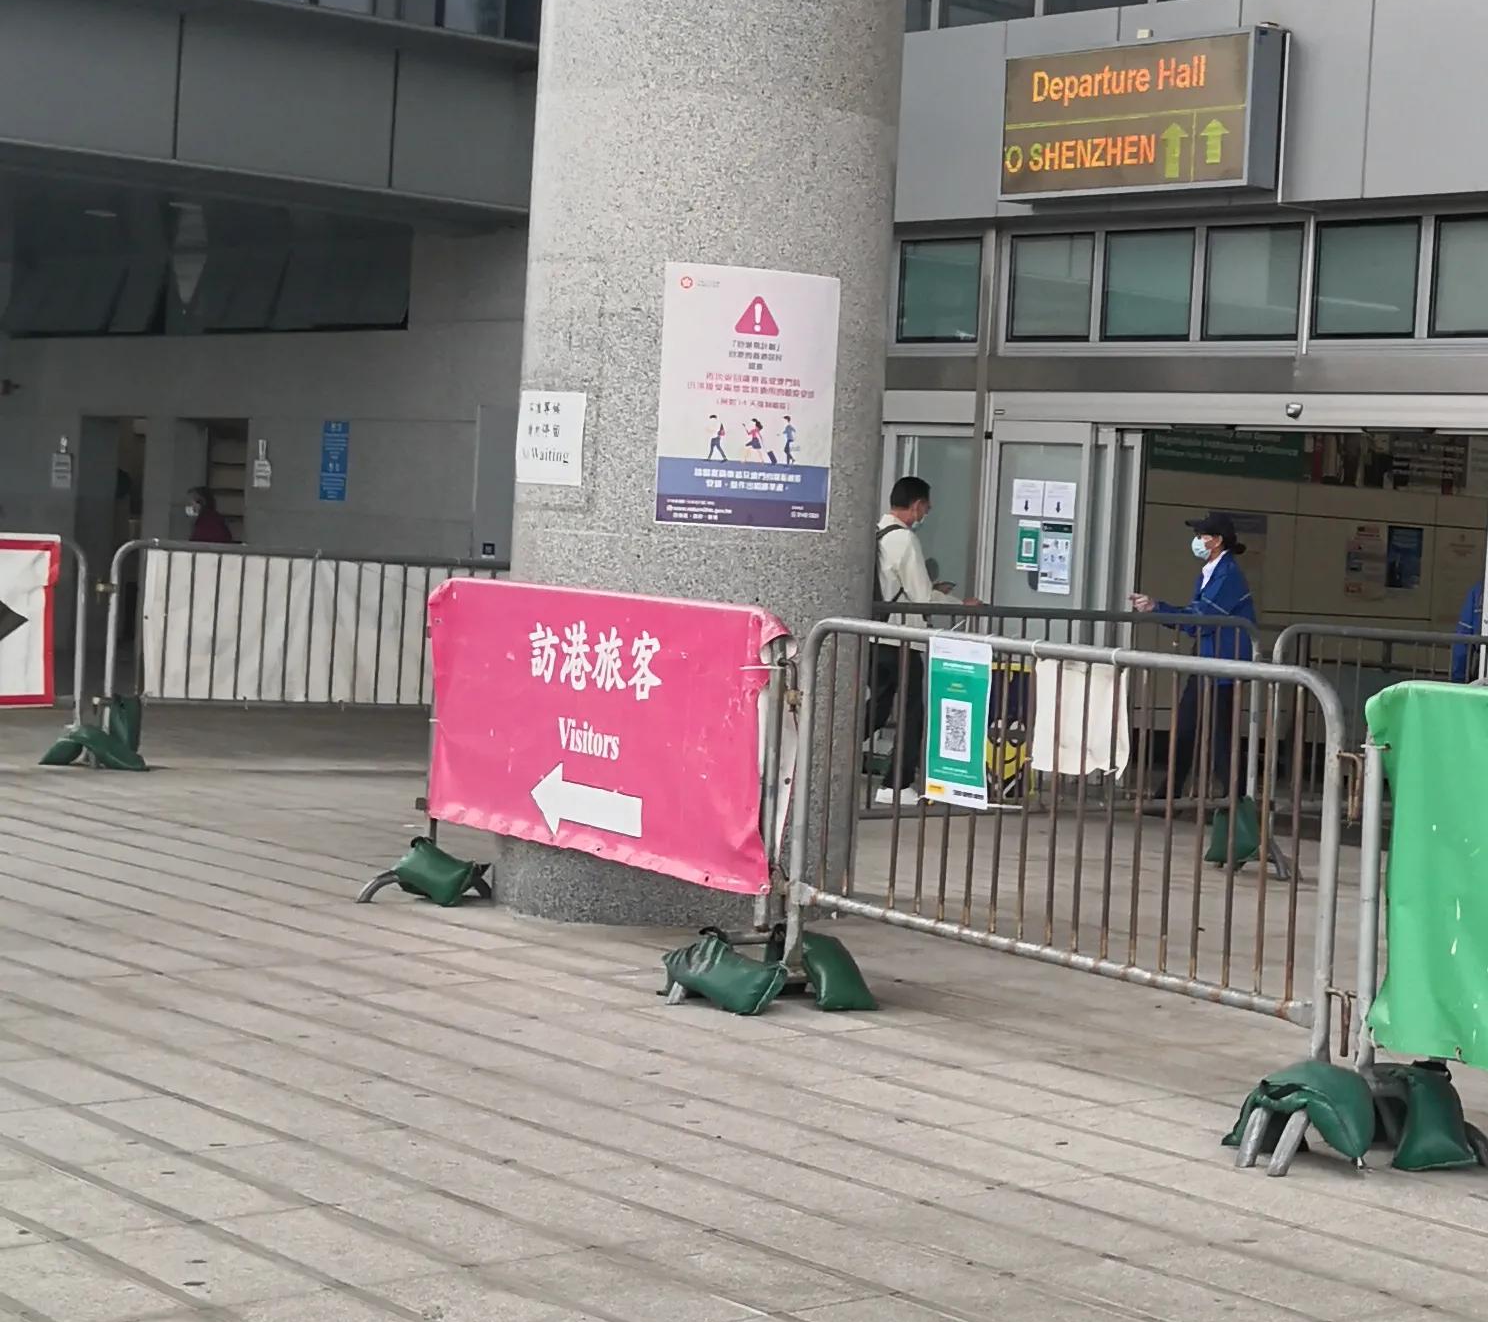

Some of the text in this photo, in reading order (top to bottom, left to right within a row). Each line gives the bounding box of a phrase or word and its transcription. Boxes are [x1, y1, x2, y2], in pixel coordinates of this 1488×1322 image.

[1032, 55, 1207, 107] Departure Hall
[1004, 134, 1155, 173] O SHENZHEN
[528, 620, 663, 701] 訪港旅客
[558, 716, 620, 761] Visitors
